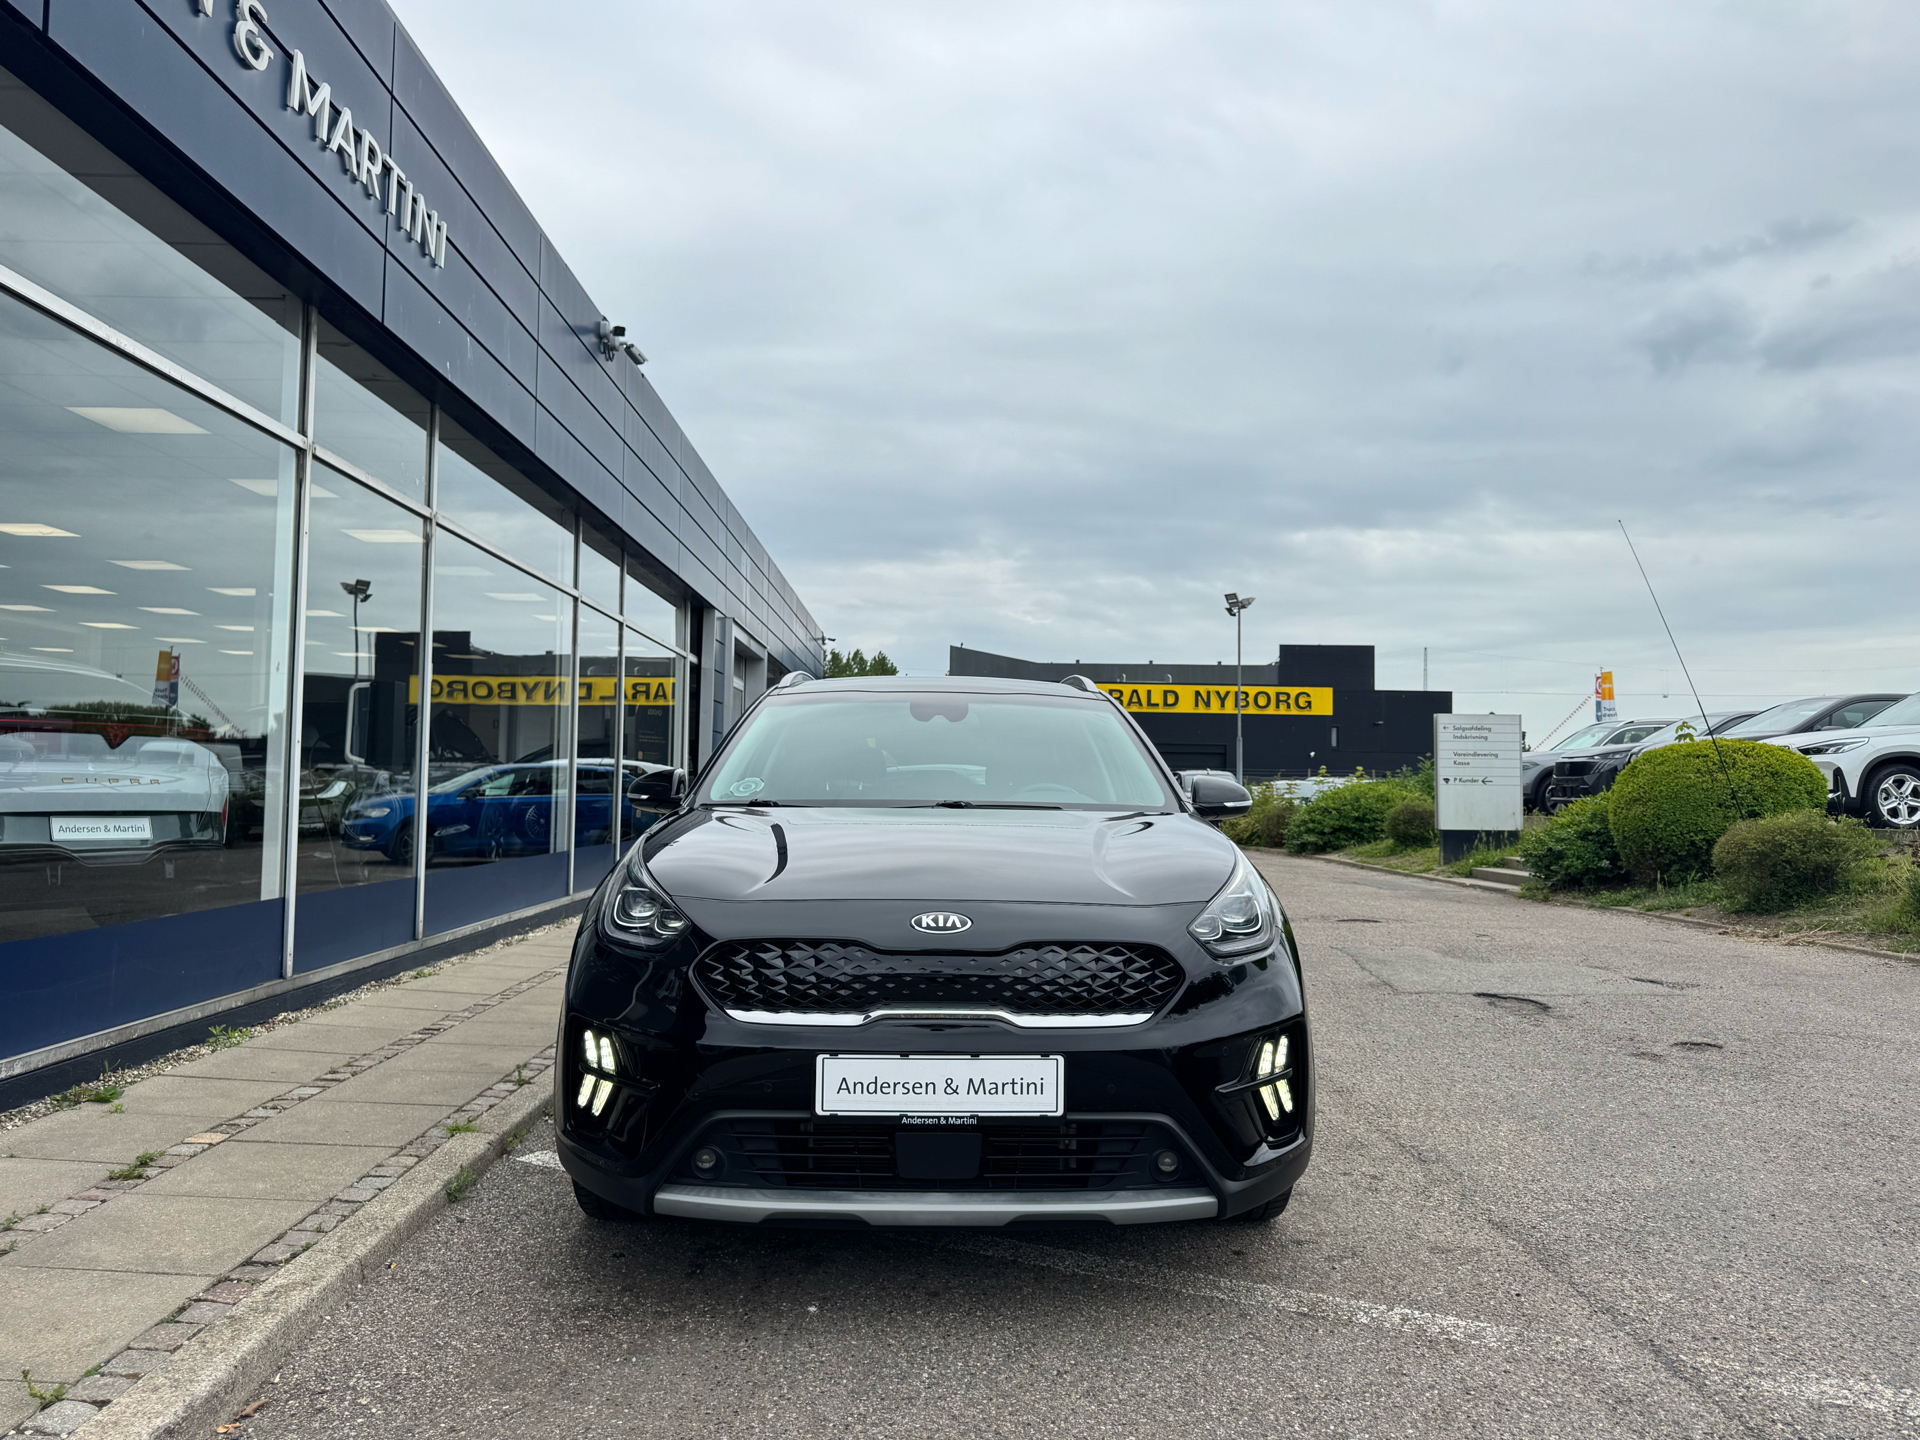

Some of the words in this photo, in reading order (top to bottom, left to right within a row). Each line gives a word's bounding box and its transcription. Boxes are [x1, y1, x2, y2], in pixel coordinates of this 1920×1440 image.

[287, 49, 447, 269] MARTINI
[1194, 690, 1312, 710] NYBORG
[1452, 725, 1492, 733] Salgsafdeling
[1453, 751, 1499, 759] Vareindlevering
[61, 777, 161, 785] CUPRA
[58, 824, 101, 833] Andersen
[104, 825, 111, 833] &
[113, 823, 145, 833] Martini
[921, 914, 962, 928] KIA
[836, 1076, 937, 1095] Andersen
[943, 1077, 960, 1095] &
[966, 1077, 1044, 1095] Martini
[901, 1116, 938, 1125] Andersen
[940, 1116, 946, 1125] &
[948, 1116, 977, 1125] Martini
